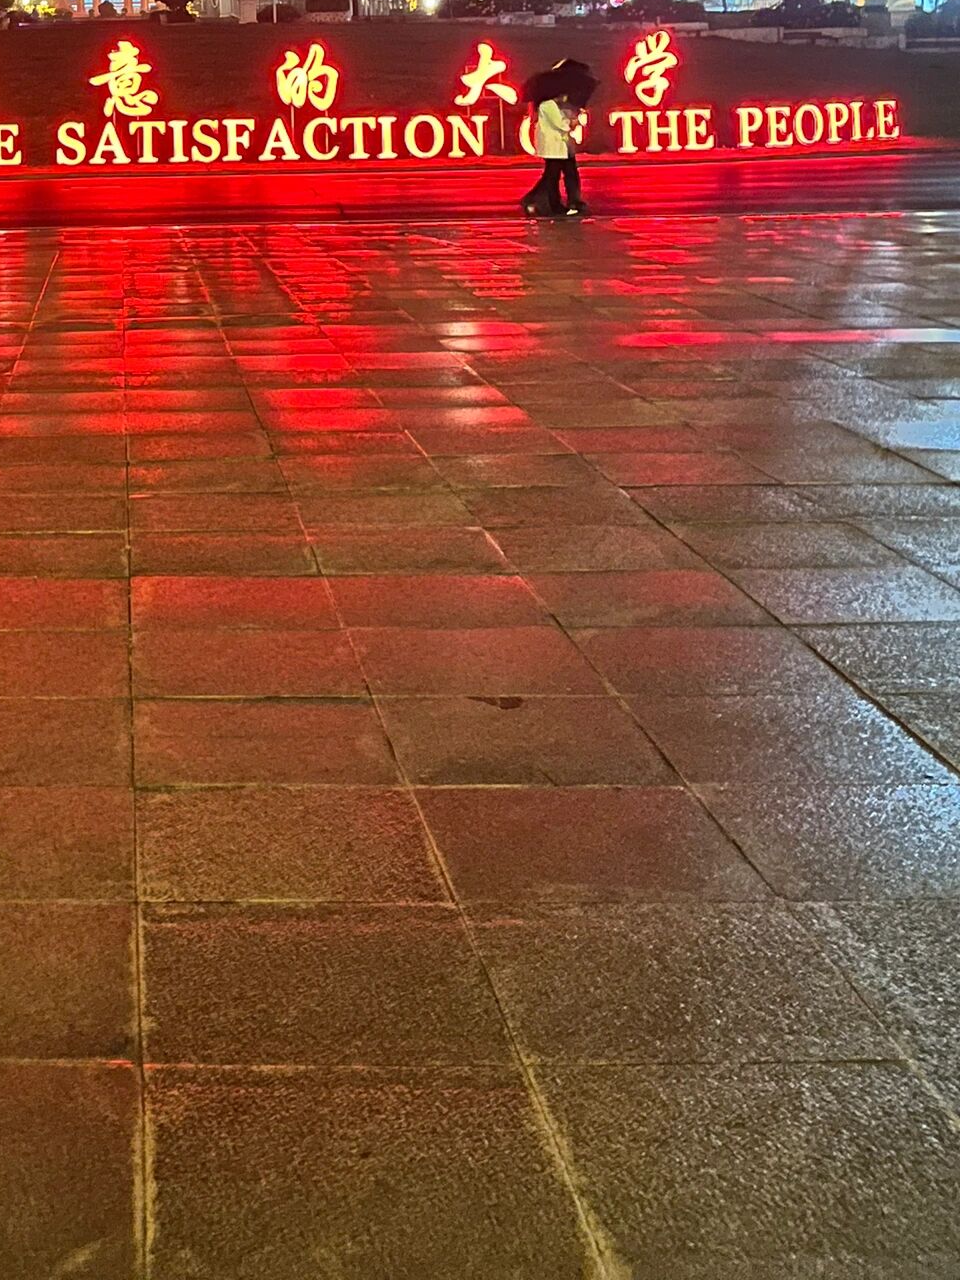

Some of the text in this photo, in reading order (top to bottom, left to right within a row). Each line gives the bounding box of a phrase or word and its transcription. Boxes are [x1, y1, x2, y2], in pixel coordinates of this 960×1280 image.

[56, 115, 489, 166] SATISFACTION
[608, 107, 716, 154] THE
[735, 99, 901, 148] PEOPLE
